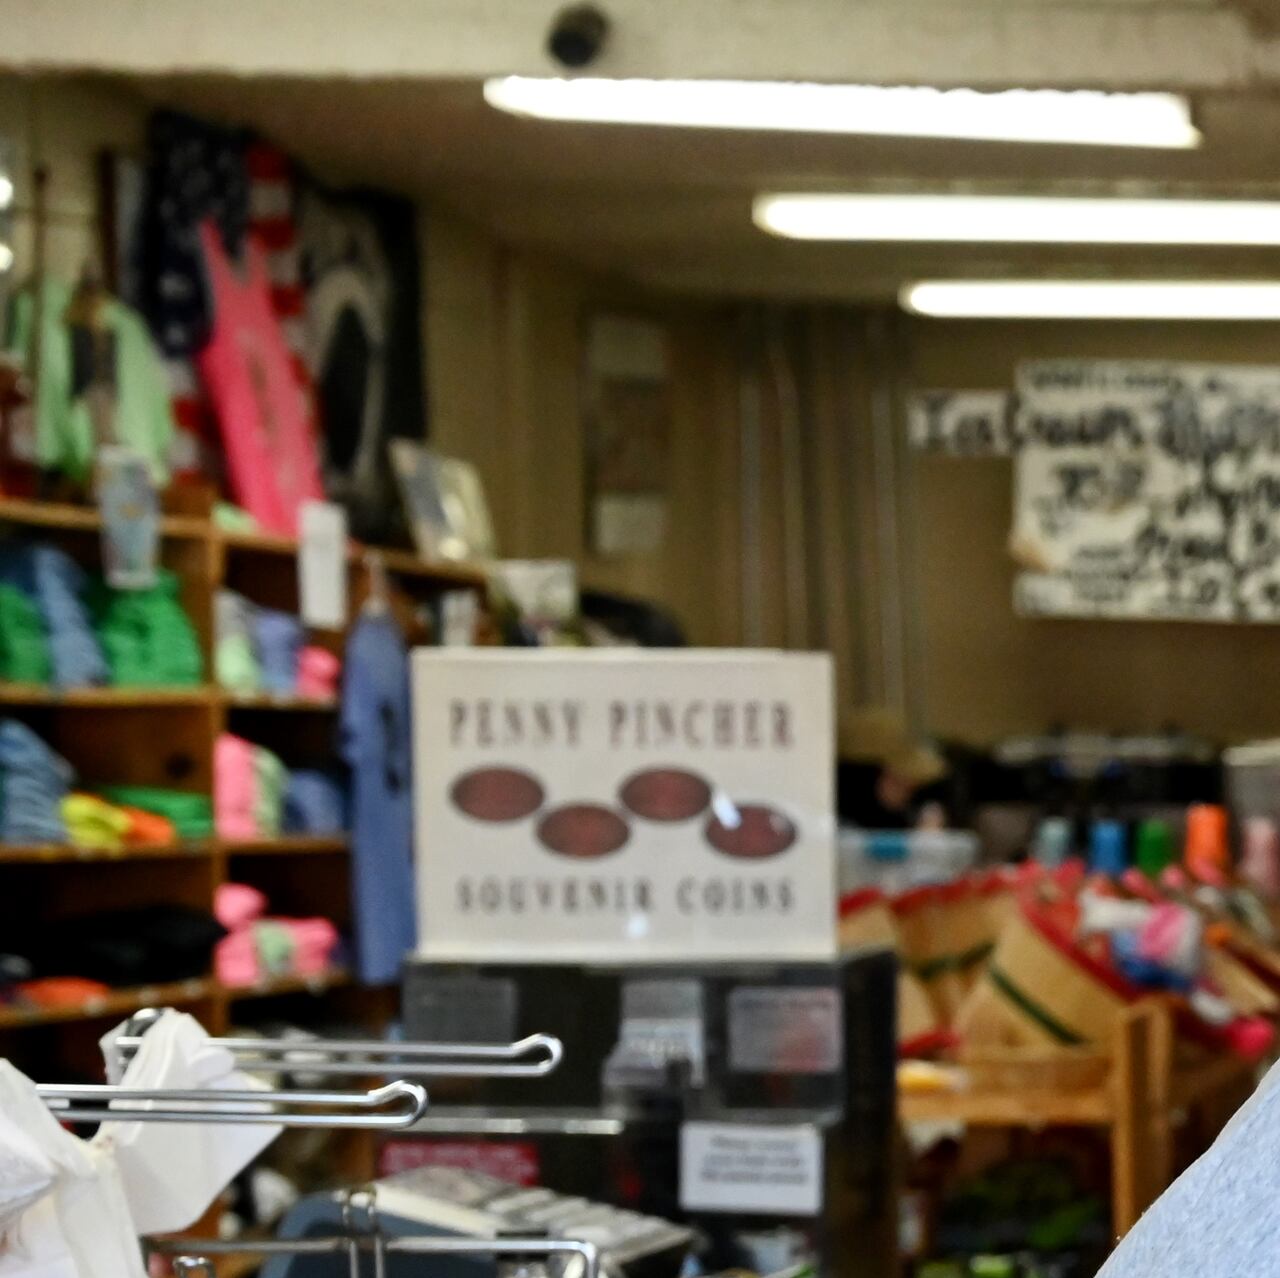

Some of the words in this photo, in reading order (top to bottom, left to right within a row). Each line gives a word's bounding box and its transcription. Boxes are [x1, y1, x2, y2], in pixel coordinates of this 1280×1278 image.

[449, 698, 583, 748] PENNY
[608, 698, 794, 748] PINCHER
[456, 874, 652, 914] SOUVENIR
[674, 874, 796, 914] COINS
